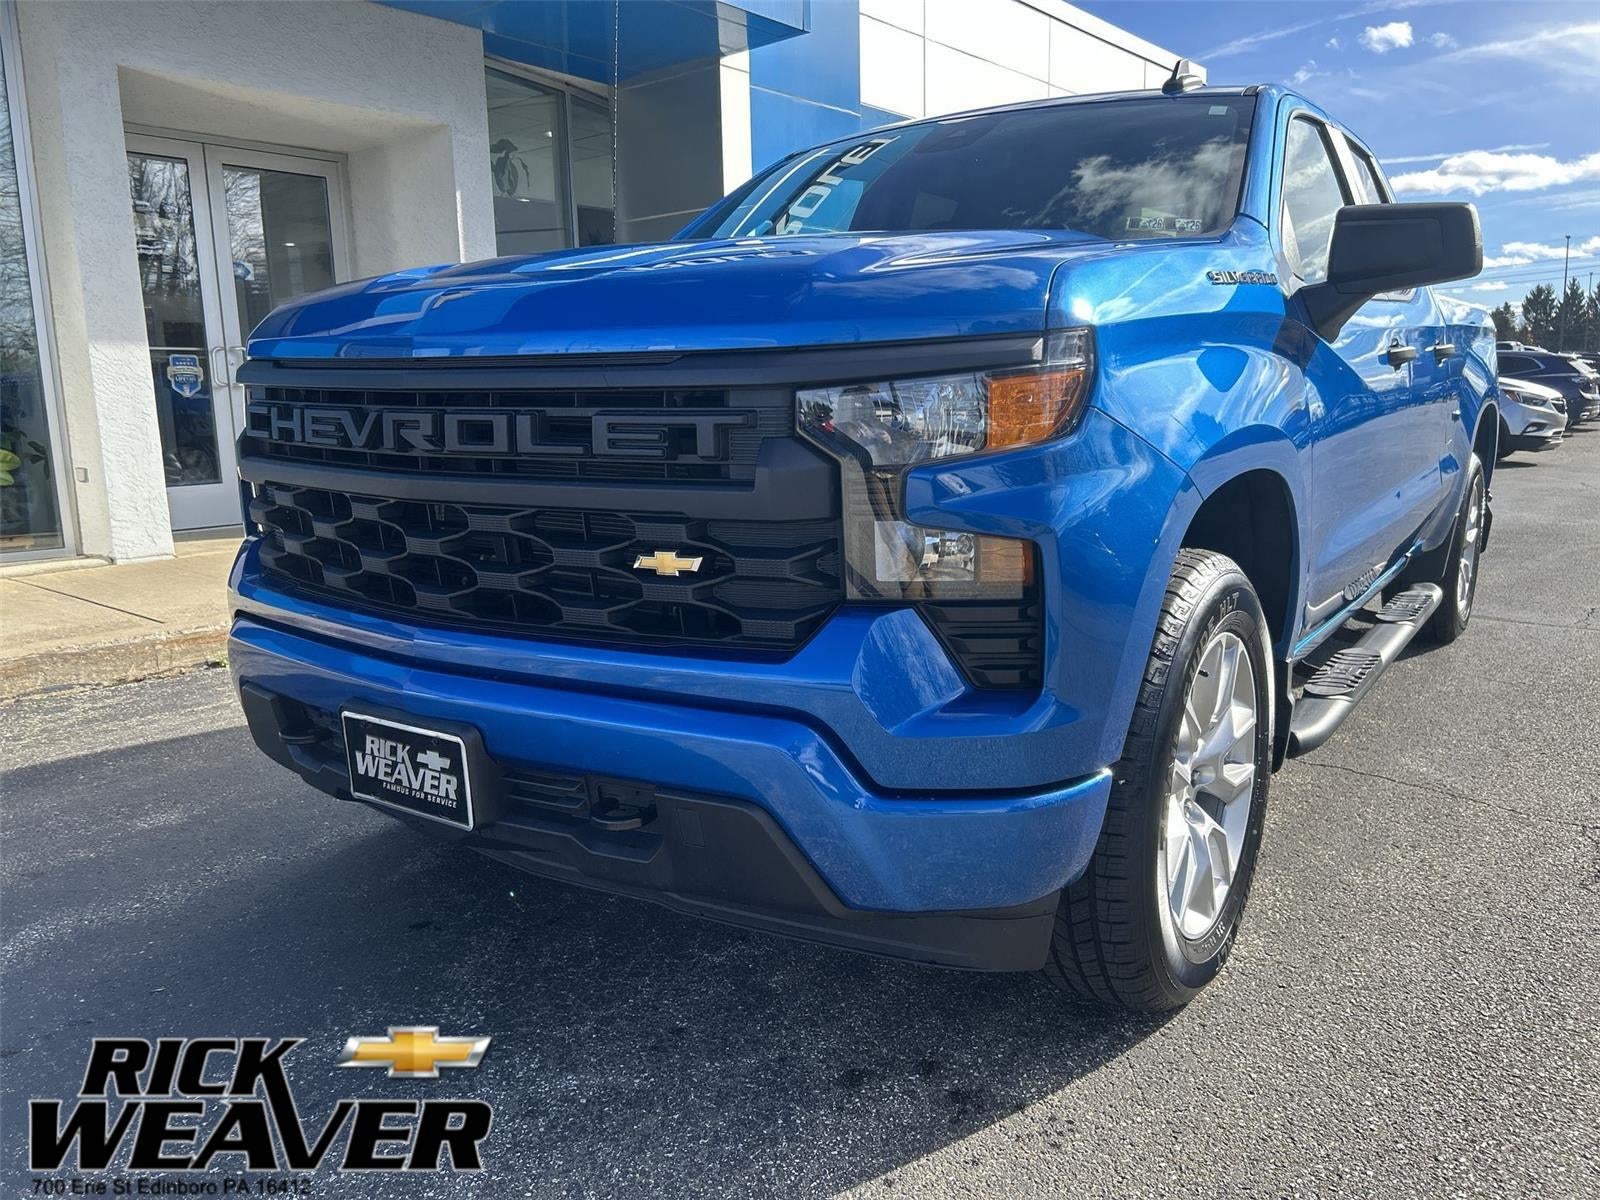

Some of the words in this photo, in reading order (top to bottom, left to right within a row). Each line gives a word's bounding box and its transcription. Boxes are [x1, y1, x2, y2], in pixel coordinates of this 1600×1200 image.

[1211, 271, 1278, 285] SILVERADO
[246, 404, 754, 459] CHEVROLET
[365, 734, 411, 763] RICK
[355, 751, 458, 800] WEAVER
[383, 782, 410, 795] FAMOUS
[412, 790, 425, 800] FOR
[427, 795, 457, 808] SERVICE
